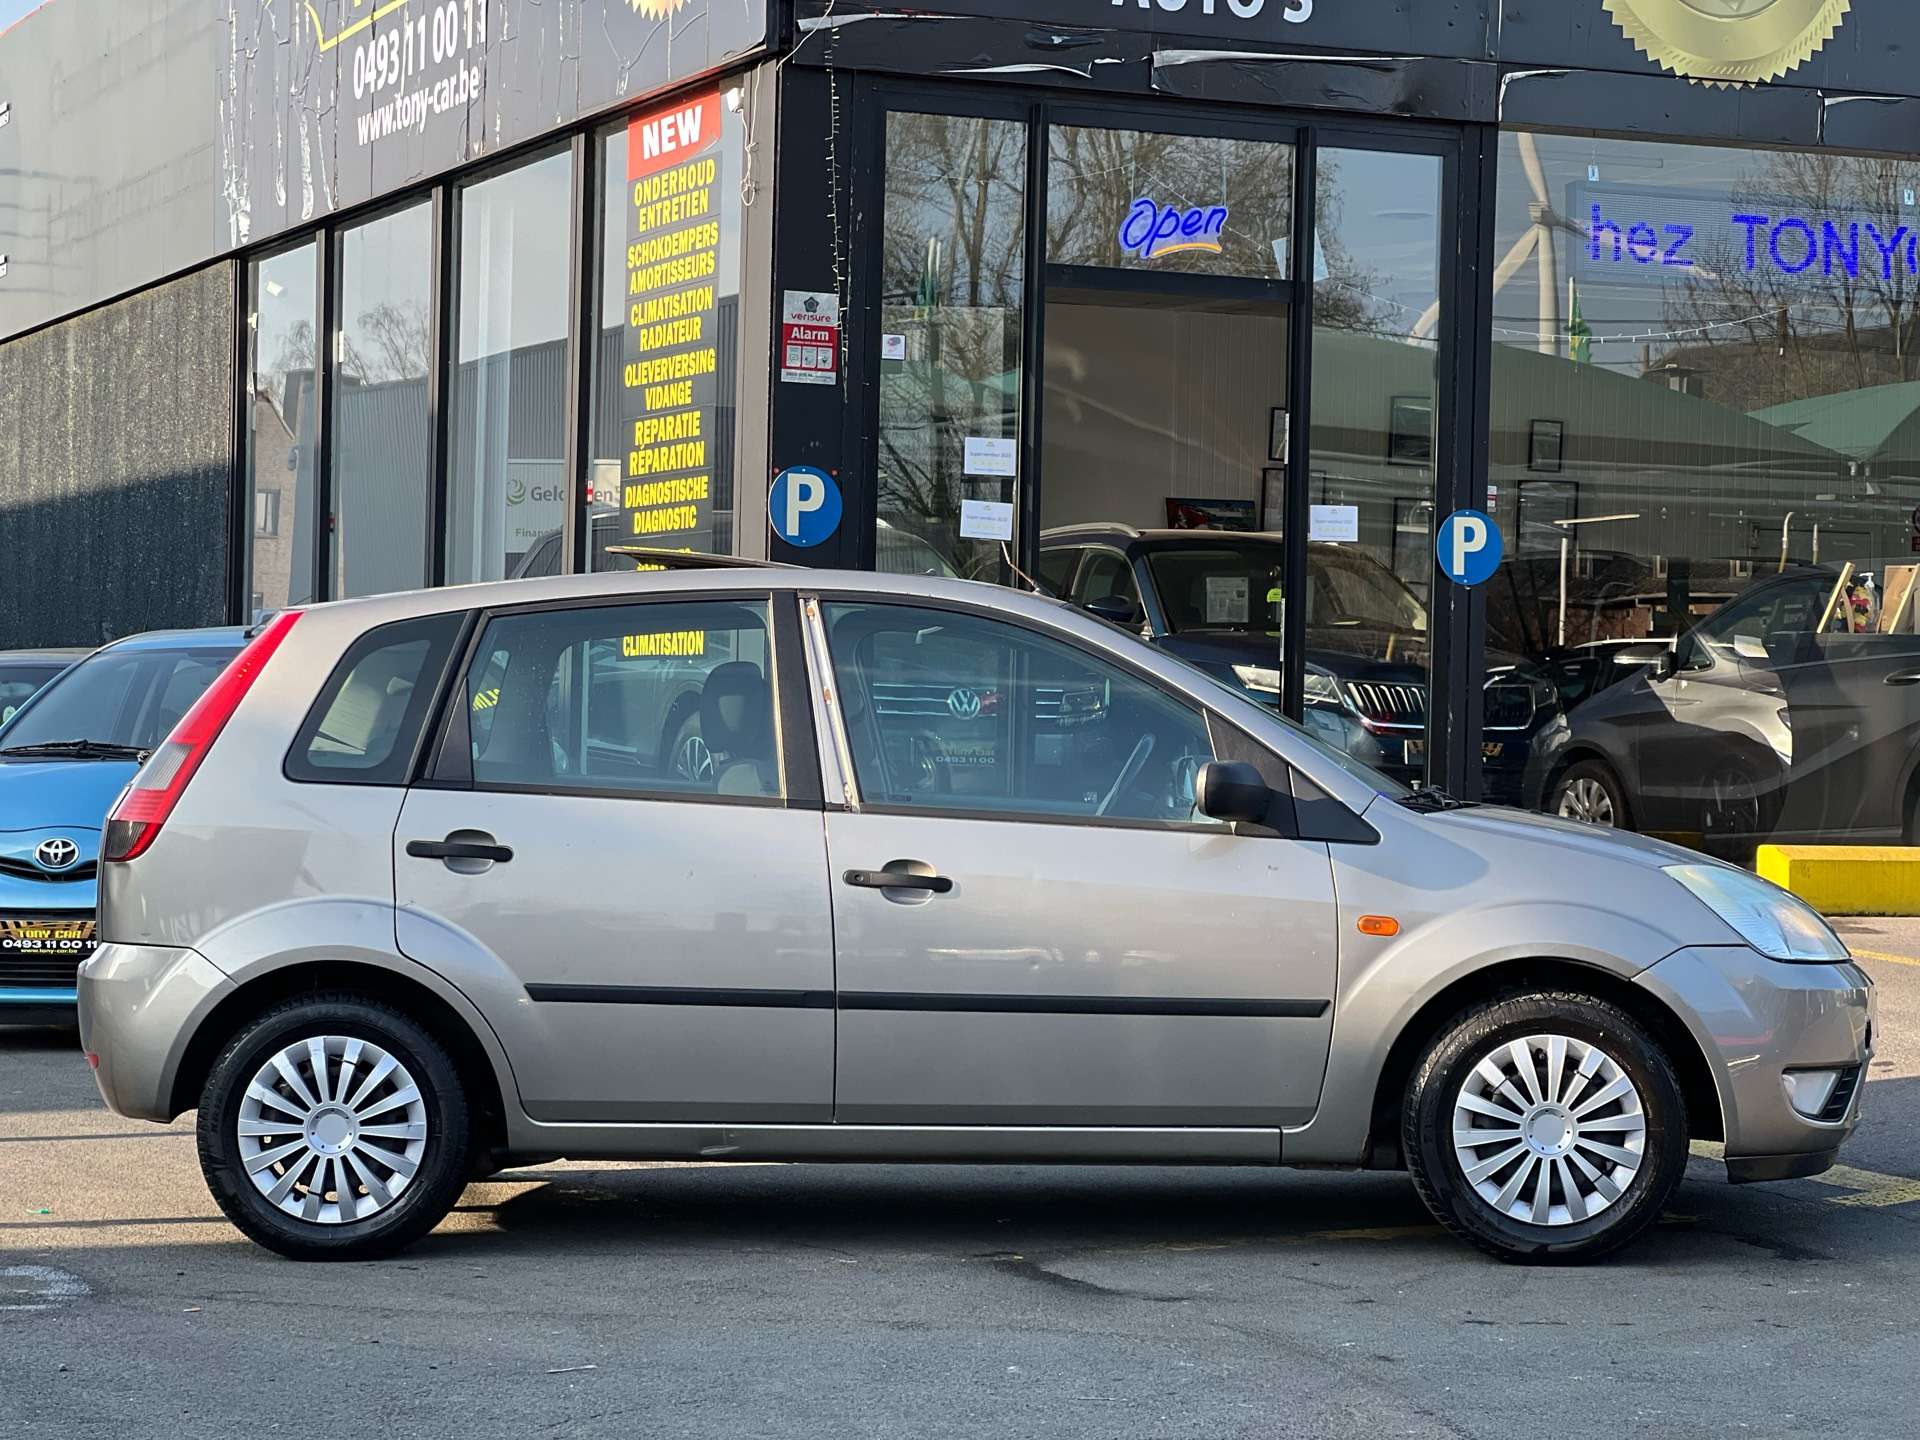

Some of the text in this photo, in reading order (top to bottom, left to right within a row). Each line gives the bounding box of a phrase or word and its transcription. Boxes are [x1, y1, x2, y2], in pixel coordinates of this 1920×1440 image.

[432, 0, 458, 64] 00
[356, 58, 480, 146] www.tony-car.be
[642, 104, 703, 160] NEW
[634, 158, 715, 207] ONDERHOUD
[639, 187, 709, 233] ENTRETIEN
[1121, 198, 1228, 257] Open
[627, 221, 719, 269] SCHOKDEMPERS
[629, 250, 715, 295] AMORTISSEURS
[630, 285, 713, 328] CLIMATISATION
[791, 312, 832, 323] verisure
[640, 316, 702, 352] RADIATEUR
[791, 327, 829, 342] Alarm
[624, 348, 716, 388] OLIEVERVERSING
[645, 380, 692, 411] VIDANGE
[634, 410, 701, 446] REPARATIE
[629, 440, 705, 476] RÉPARATION
[625, 476, 709, 509] DIAGNOSTISCHE
[786, 472, 825, 537] P
[633, 505, 697, 535] DIAGNOSTIC
[1453, 516, 1487, 576] P
[623, 630, 704, 657] CLIMATISATION
[2, 940, 98, 948] 0493 11 00 11
[19, 930, 81, 939] TONY CAR
